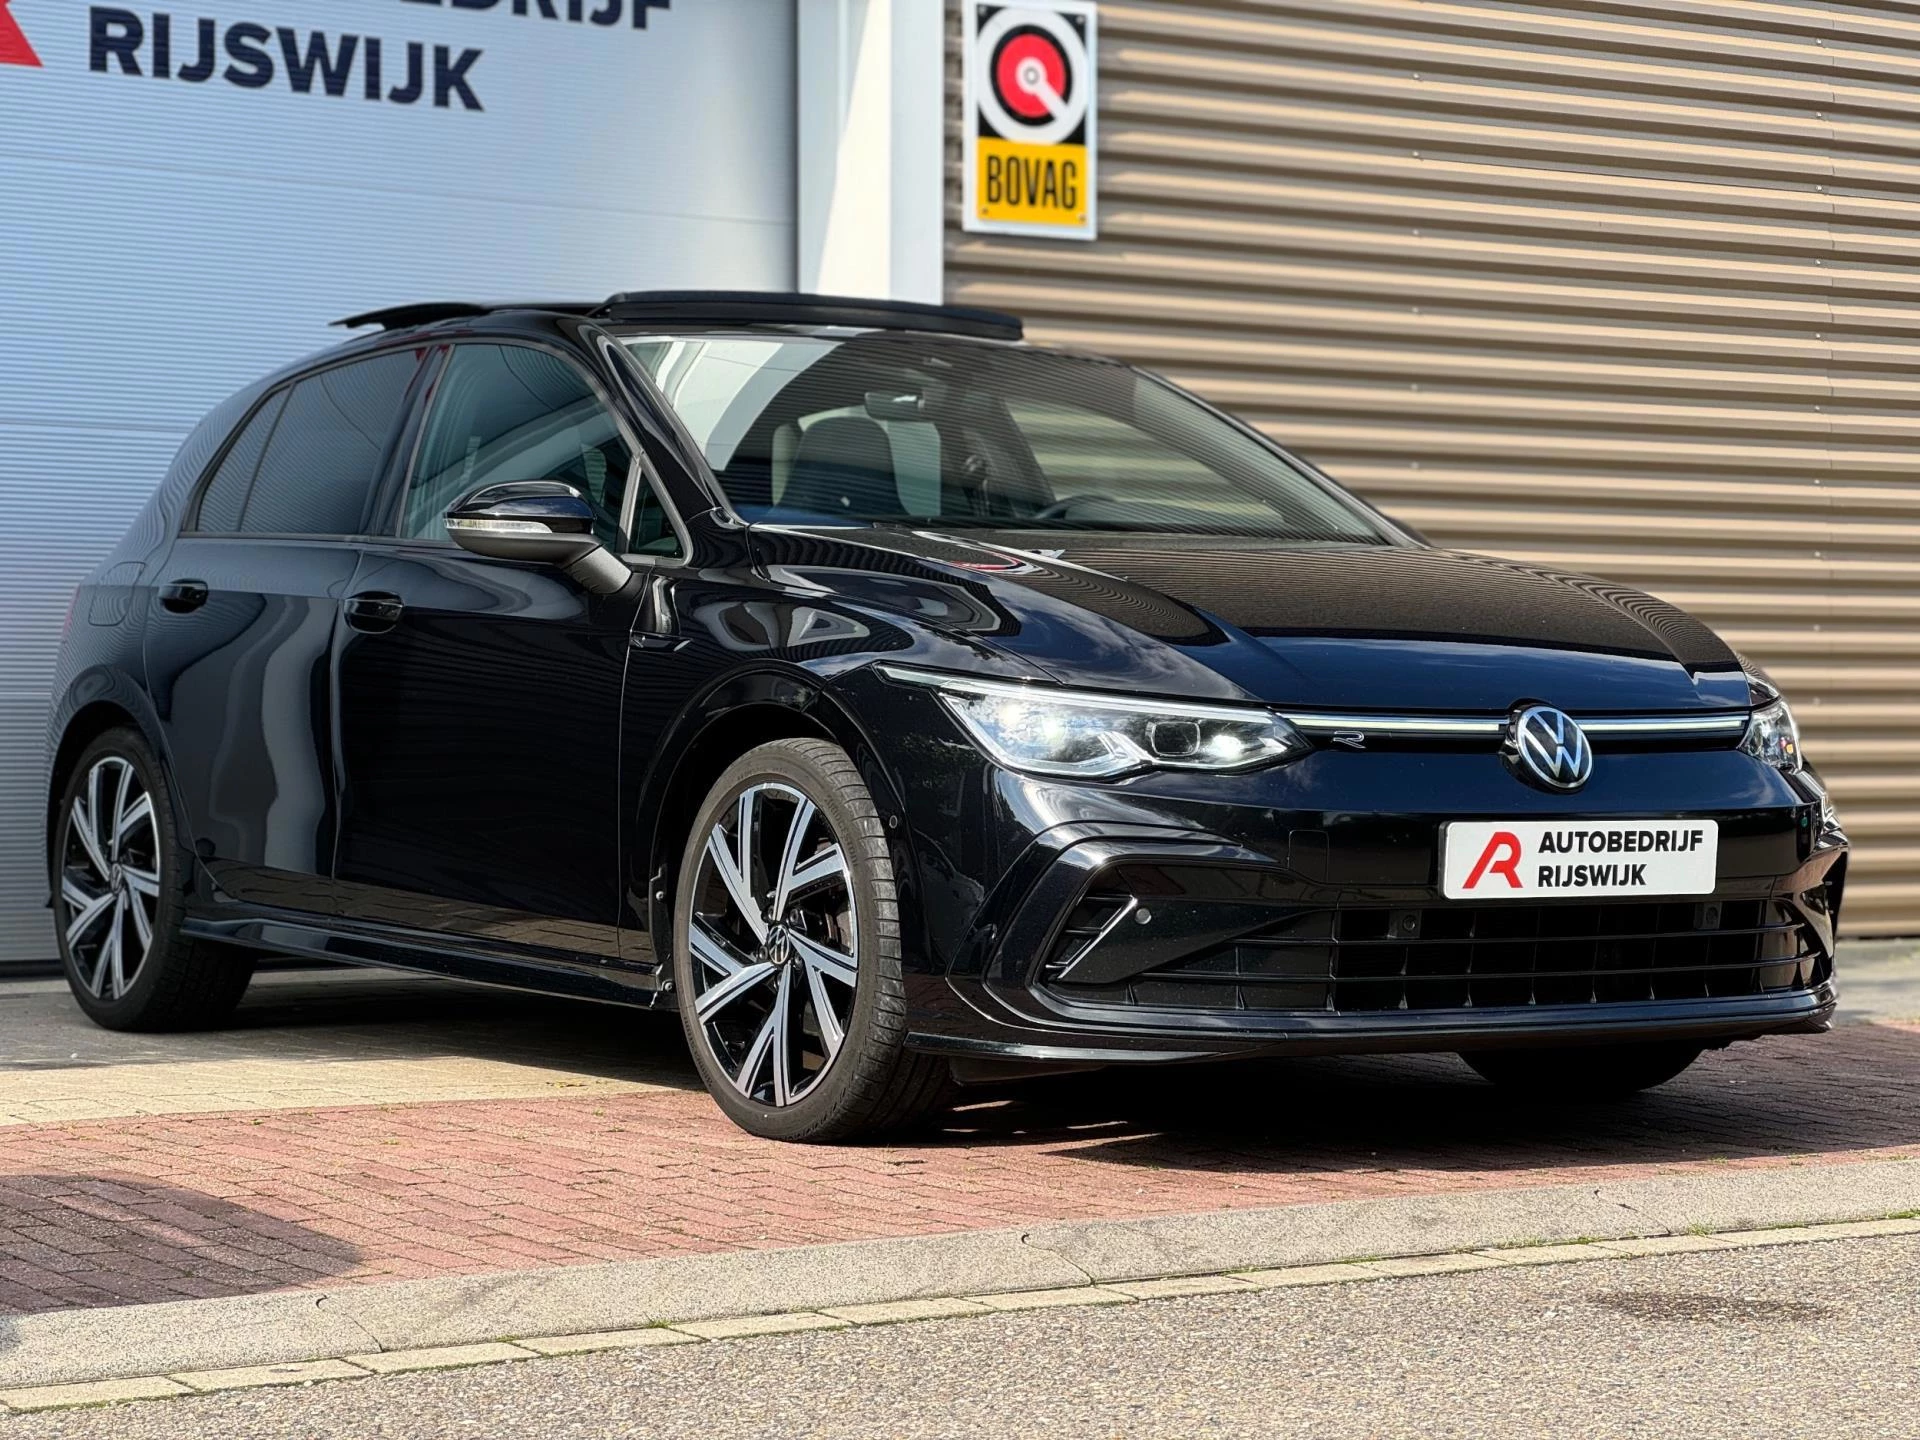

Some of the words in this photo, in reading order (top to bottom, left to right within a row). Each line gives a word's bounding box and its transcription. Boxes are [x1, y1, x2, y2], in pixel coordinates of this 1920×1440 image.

[89, 6, 484, 112] RIJSWIJK
[987, 155, 1076, 210] BOVAG
[1538, 829, 1703, 854] AUTOBEDRIJF
[1538, 863, 1647, 888] RIJSWIJK
